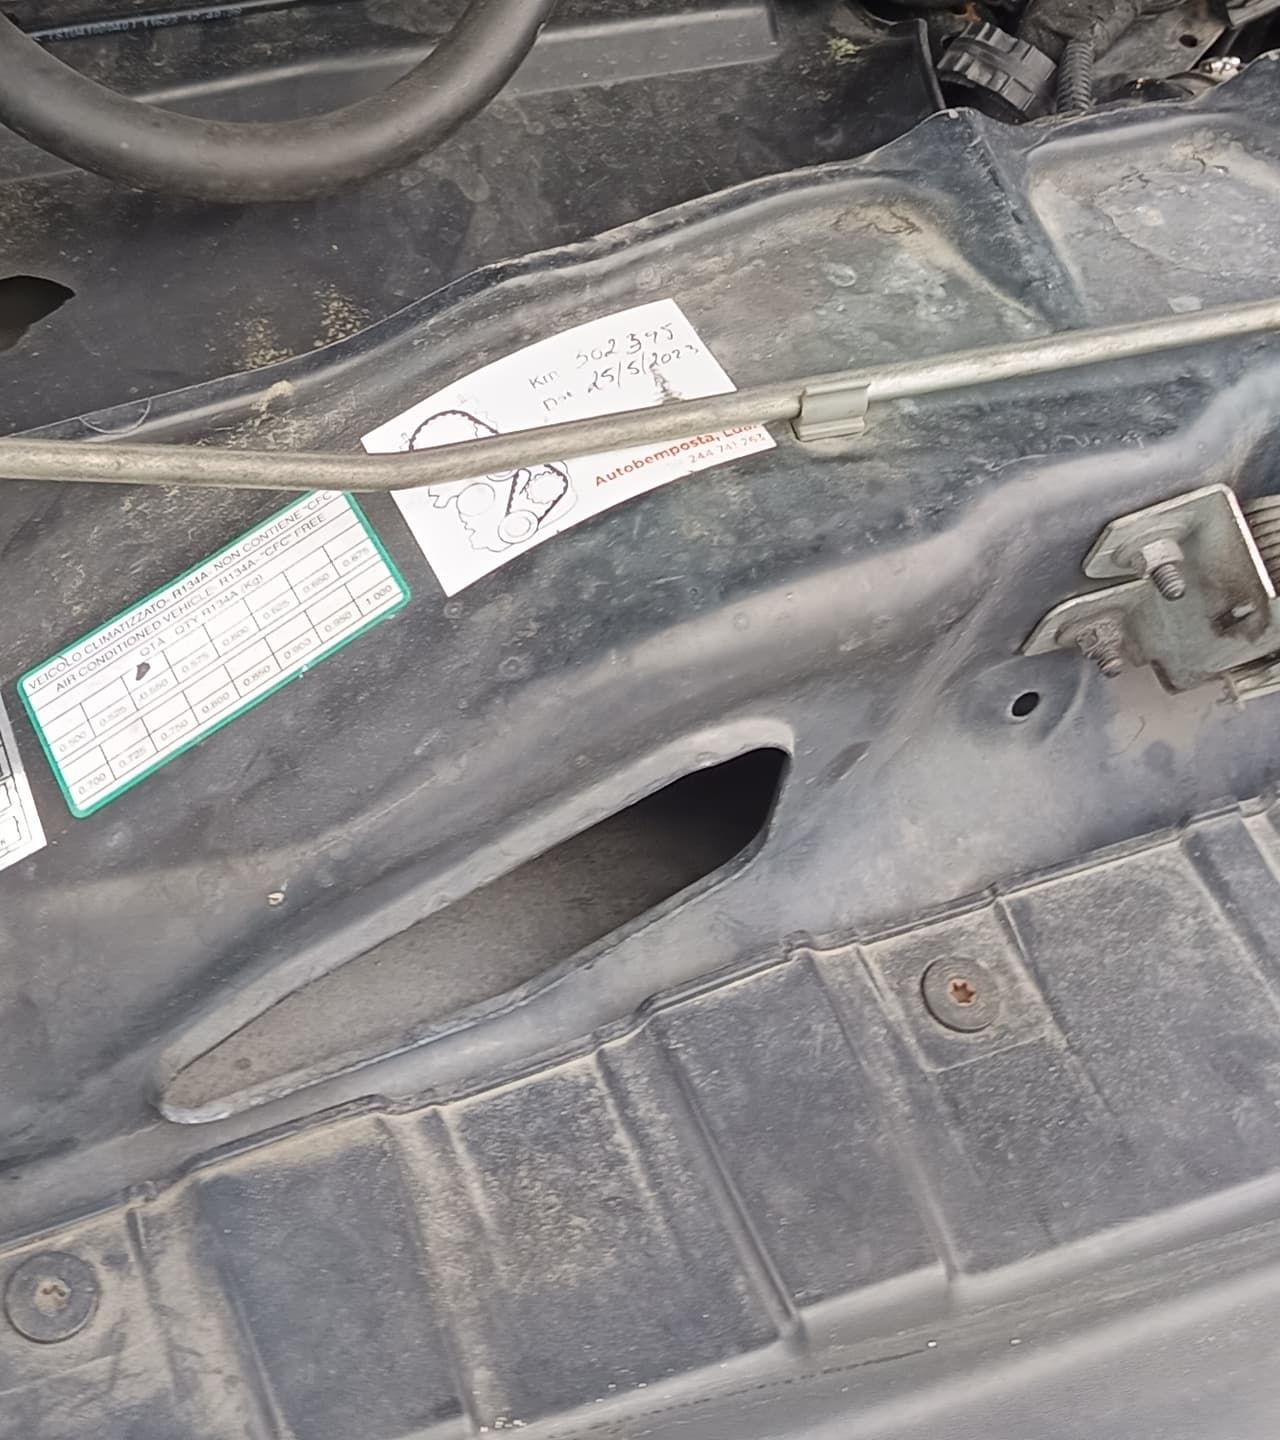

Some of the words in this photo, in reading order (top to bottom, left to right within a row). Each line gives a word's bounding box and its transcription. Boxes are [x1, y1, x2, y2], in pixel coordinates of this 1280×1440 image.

[28, 650, 83, 690] VEICOLO
[213, 549, 241, 572] NON
[241, 509, 302, 553] CONTIENE
[54, 672, 77, 692] AIR
[77, 619, 162, 678] CONDITIONED
[293, 512, 325, 538] FREE
